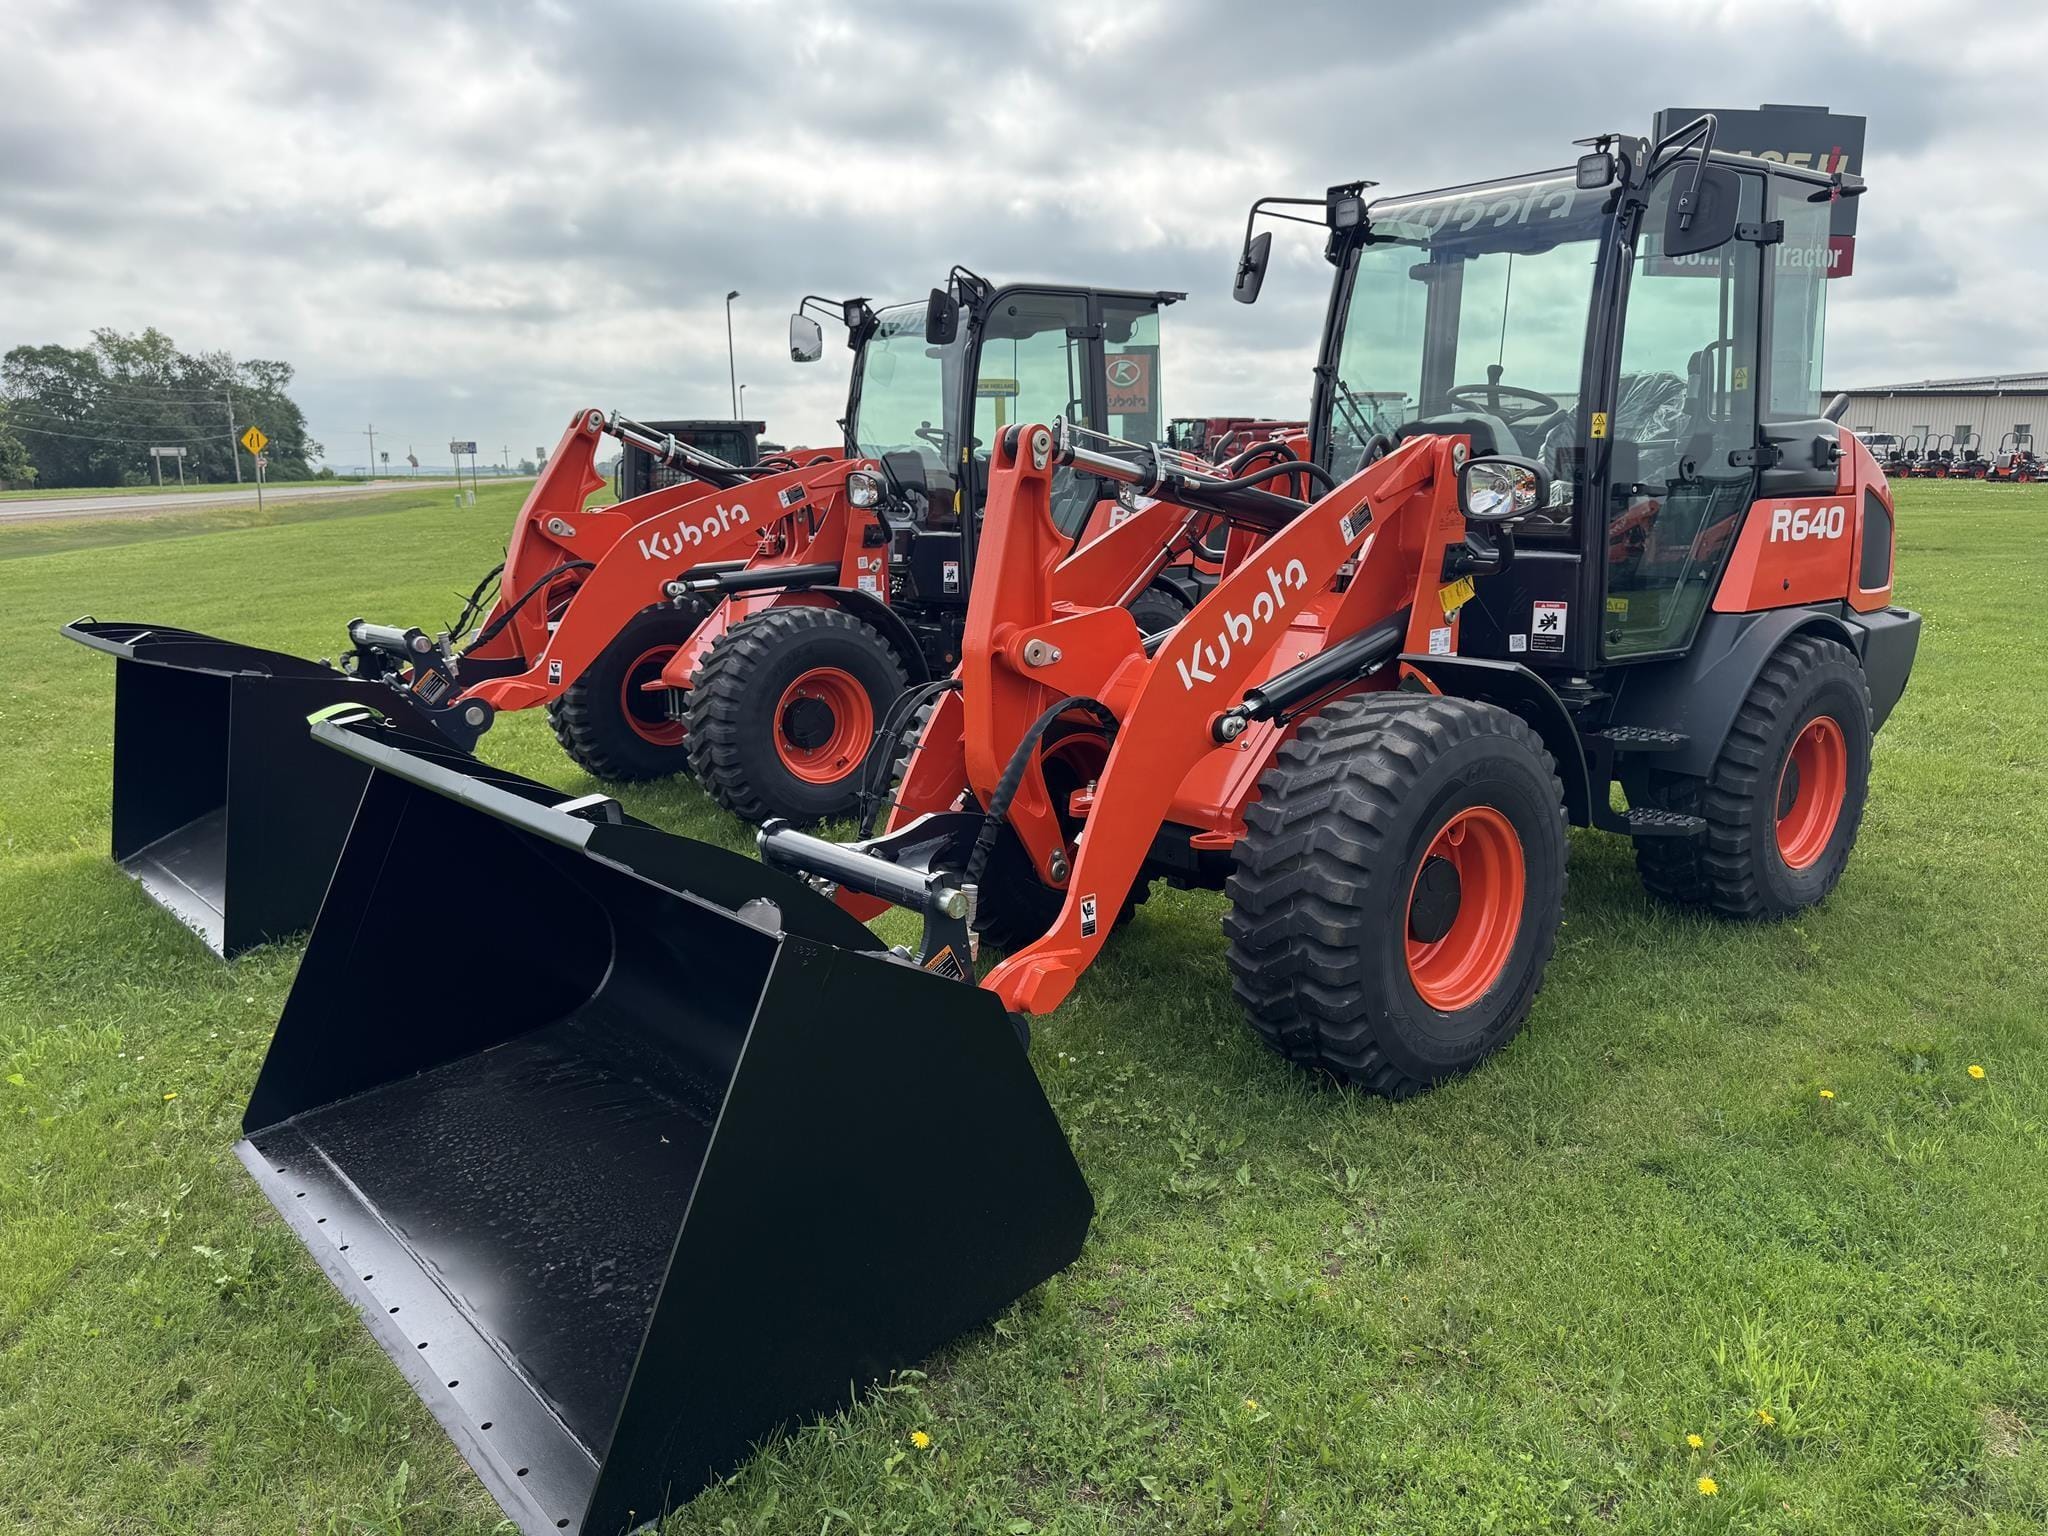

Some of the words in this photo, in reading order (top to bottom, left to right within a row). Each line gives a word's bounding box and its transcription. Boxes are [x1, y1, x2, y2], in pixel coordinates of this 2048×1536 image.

[1384, 184, 1577, 236] Kubota
[1776, 242, 1842, 268] Tractor
[1107, 395, 1146, 407] ubota
[638, 504, 750, 560] Kubota
[1770, 506, 1845, 543] R640
[1176, 558, 1308, 691] Kubota
